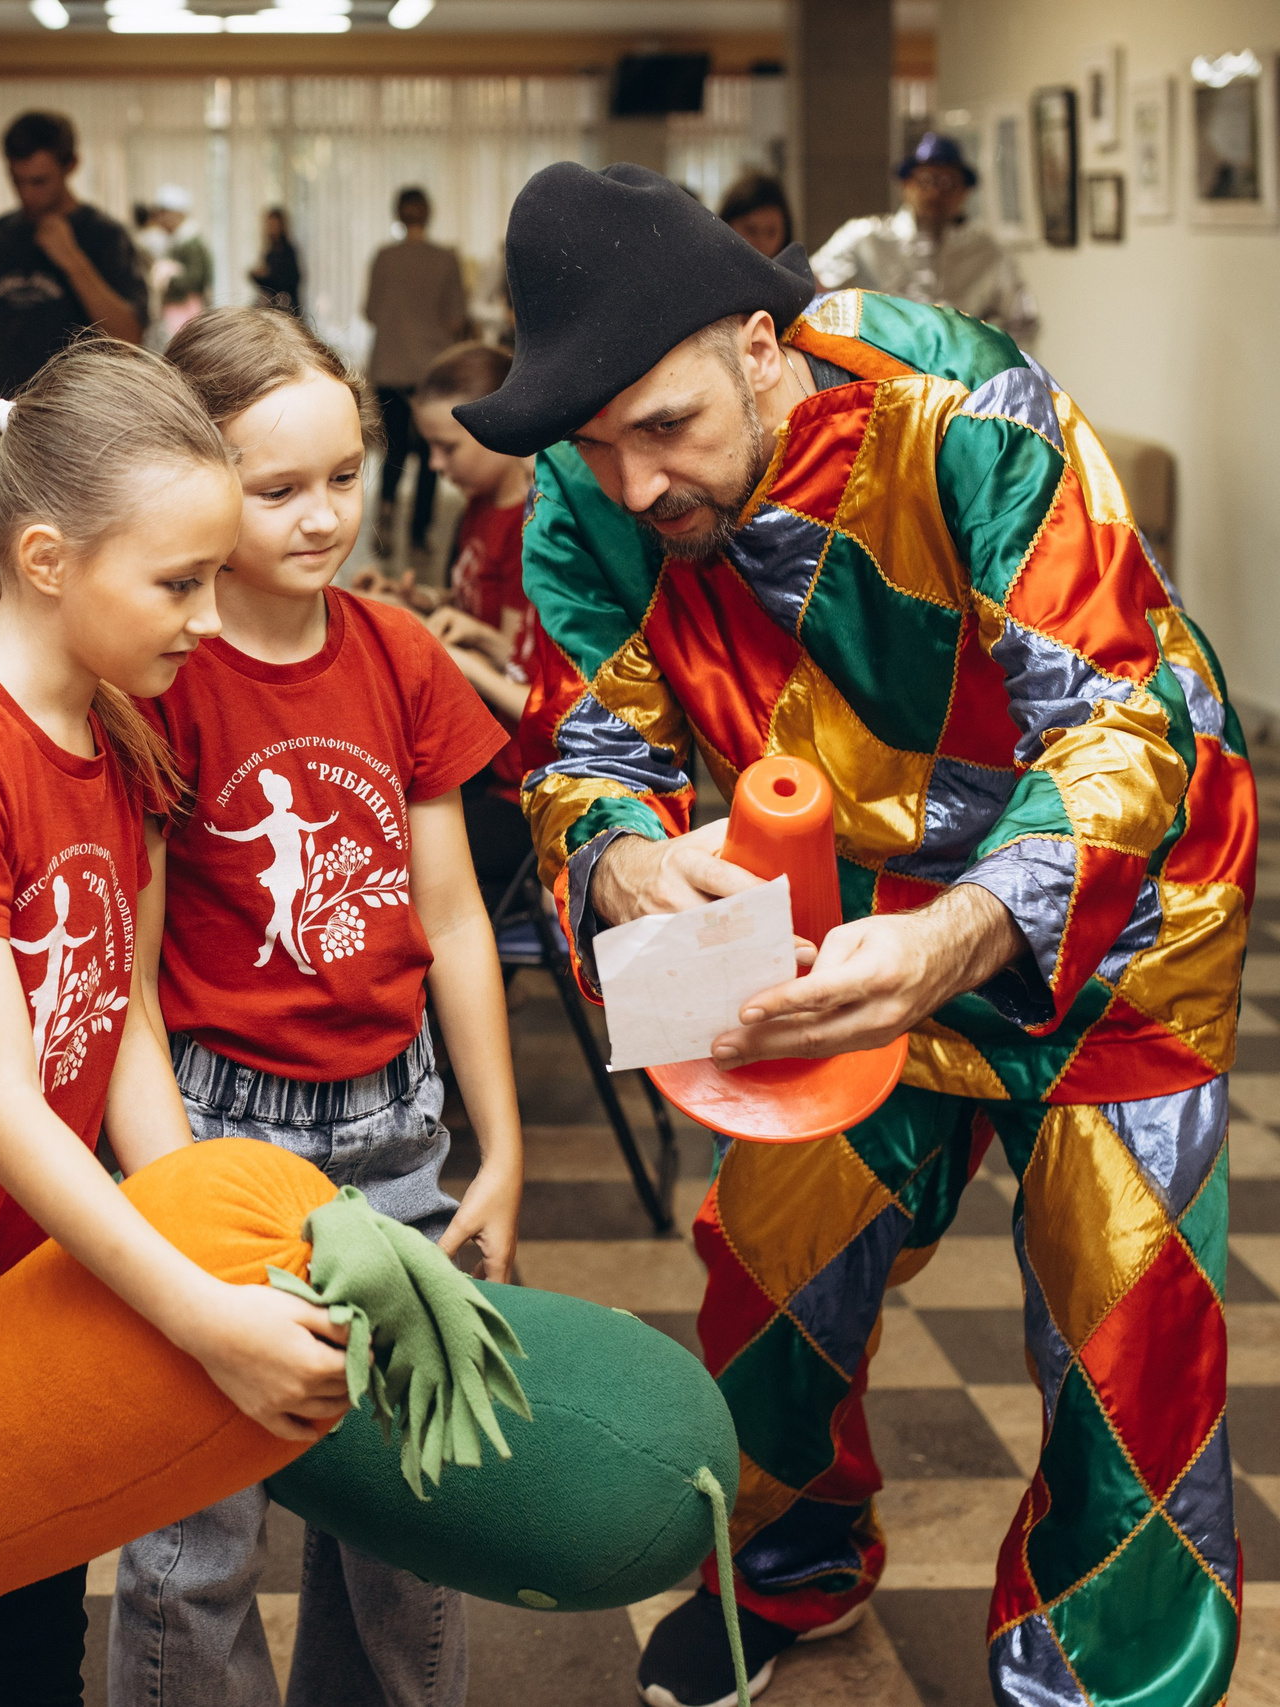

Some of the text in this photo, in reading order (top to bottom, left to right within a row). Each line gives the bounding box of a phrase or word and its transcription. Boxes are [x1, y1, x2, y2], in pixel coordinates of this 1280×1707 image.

[216, 752, 264, 808] ДЕТСКИЙ
[262, 736, 392, 778] ХОРЕОГРАФИЧЕСКИЙ
[14, 855, 60, 912] ДЕТСИЙ
[114, 888, 134, 973] КОЛЛЕКТИВ
